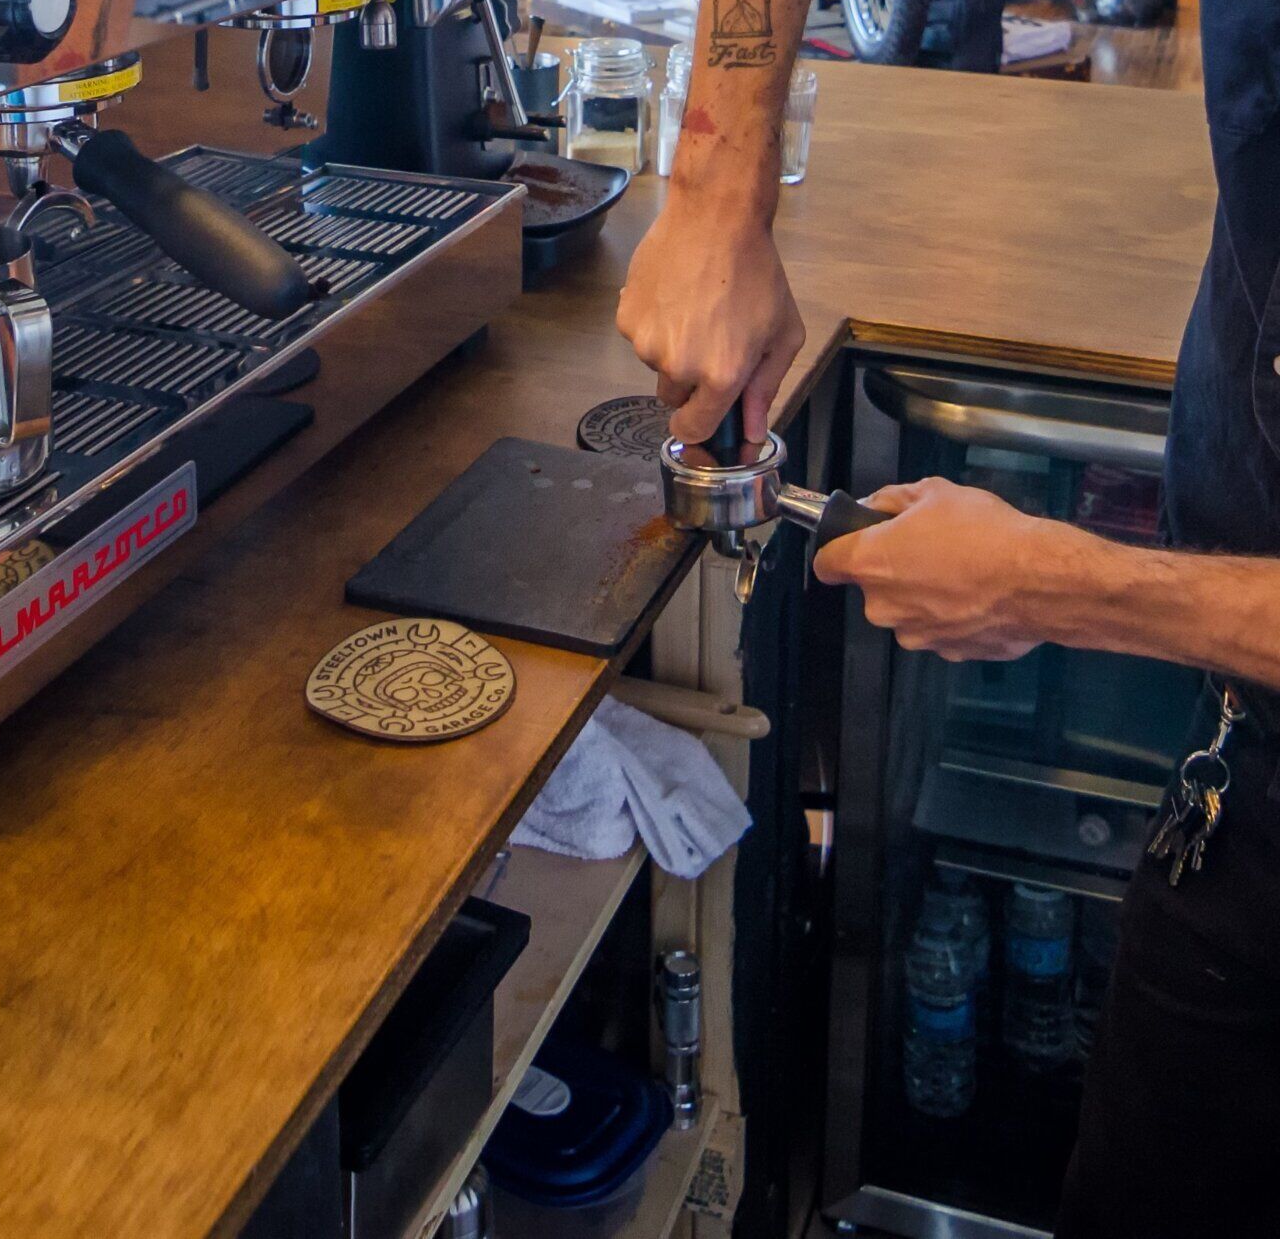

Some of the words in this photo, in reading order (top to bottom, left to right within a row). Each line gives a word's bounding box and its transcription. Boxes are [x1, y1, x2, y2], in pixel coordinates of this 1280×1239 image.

[708, 40, 777, 70] Fast
[316, 625, 398, 681] STEELTOWN
[425, 702, 491, 734] GARAGE
